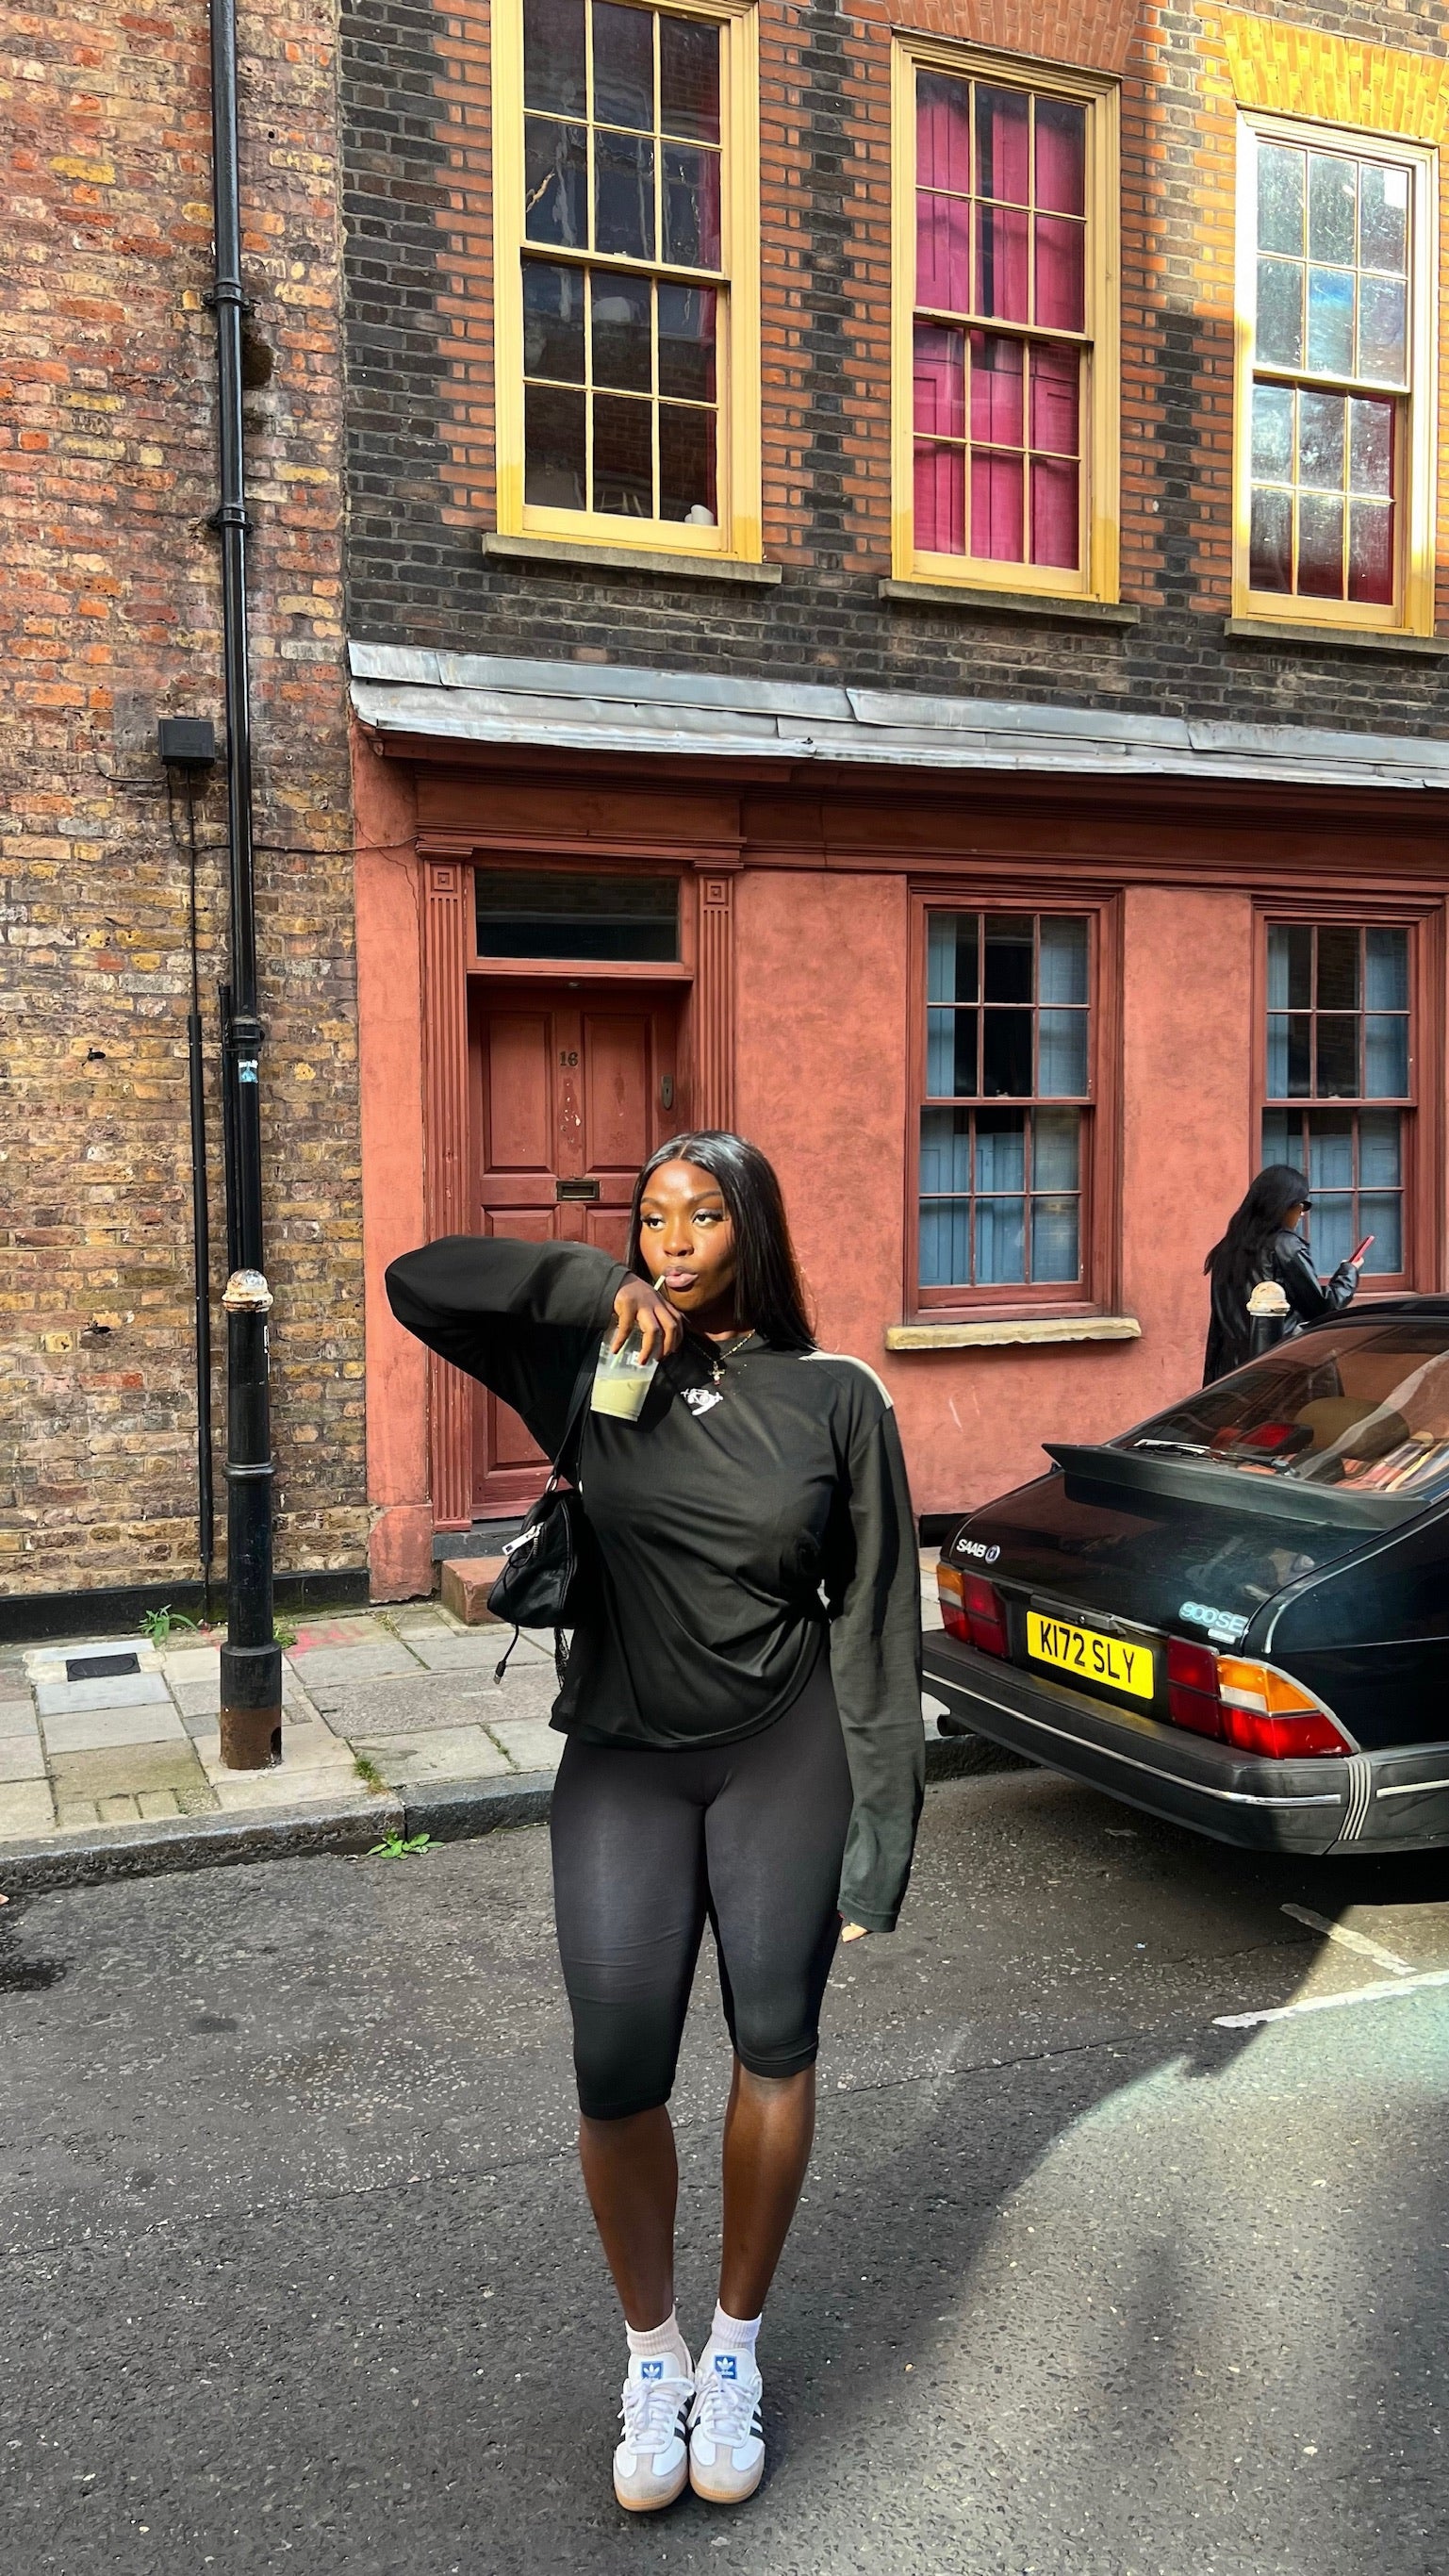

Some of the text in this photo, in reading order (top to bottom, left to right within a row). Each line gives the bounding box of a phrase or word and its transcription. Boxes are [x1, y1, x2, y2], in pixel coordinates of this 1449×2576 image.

[560, 1051, 578, 1066] 16
[956, 1538, 987, 1558] SAAB
[1040, 1620, 1134, 1683] K172 SLY
